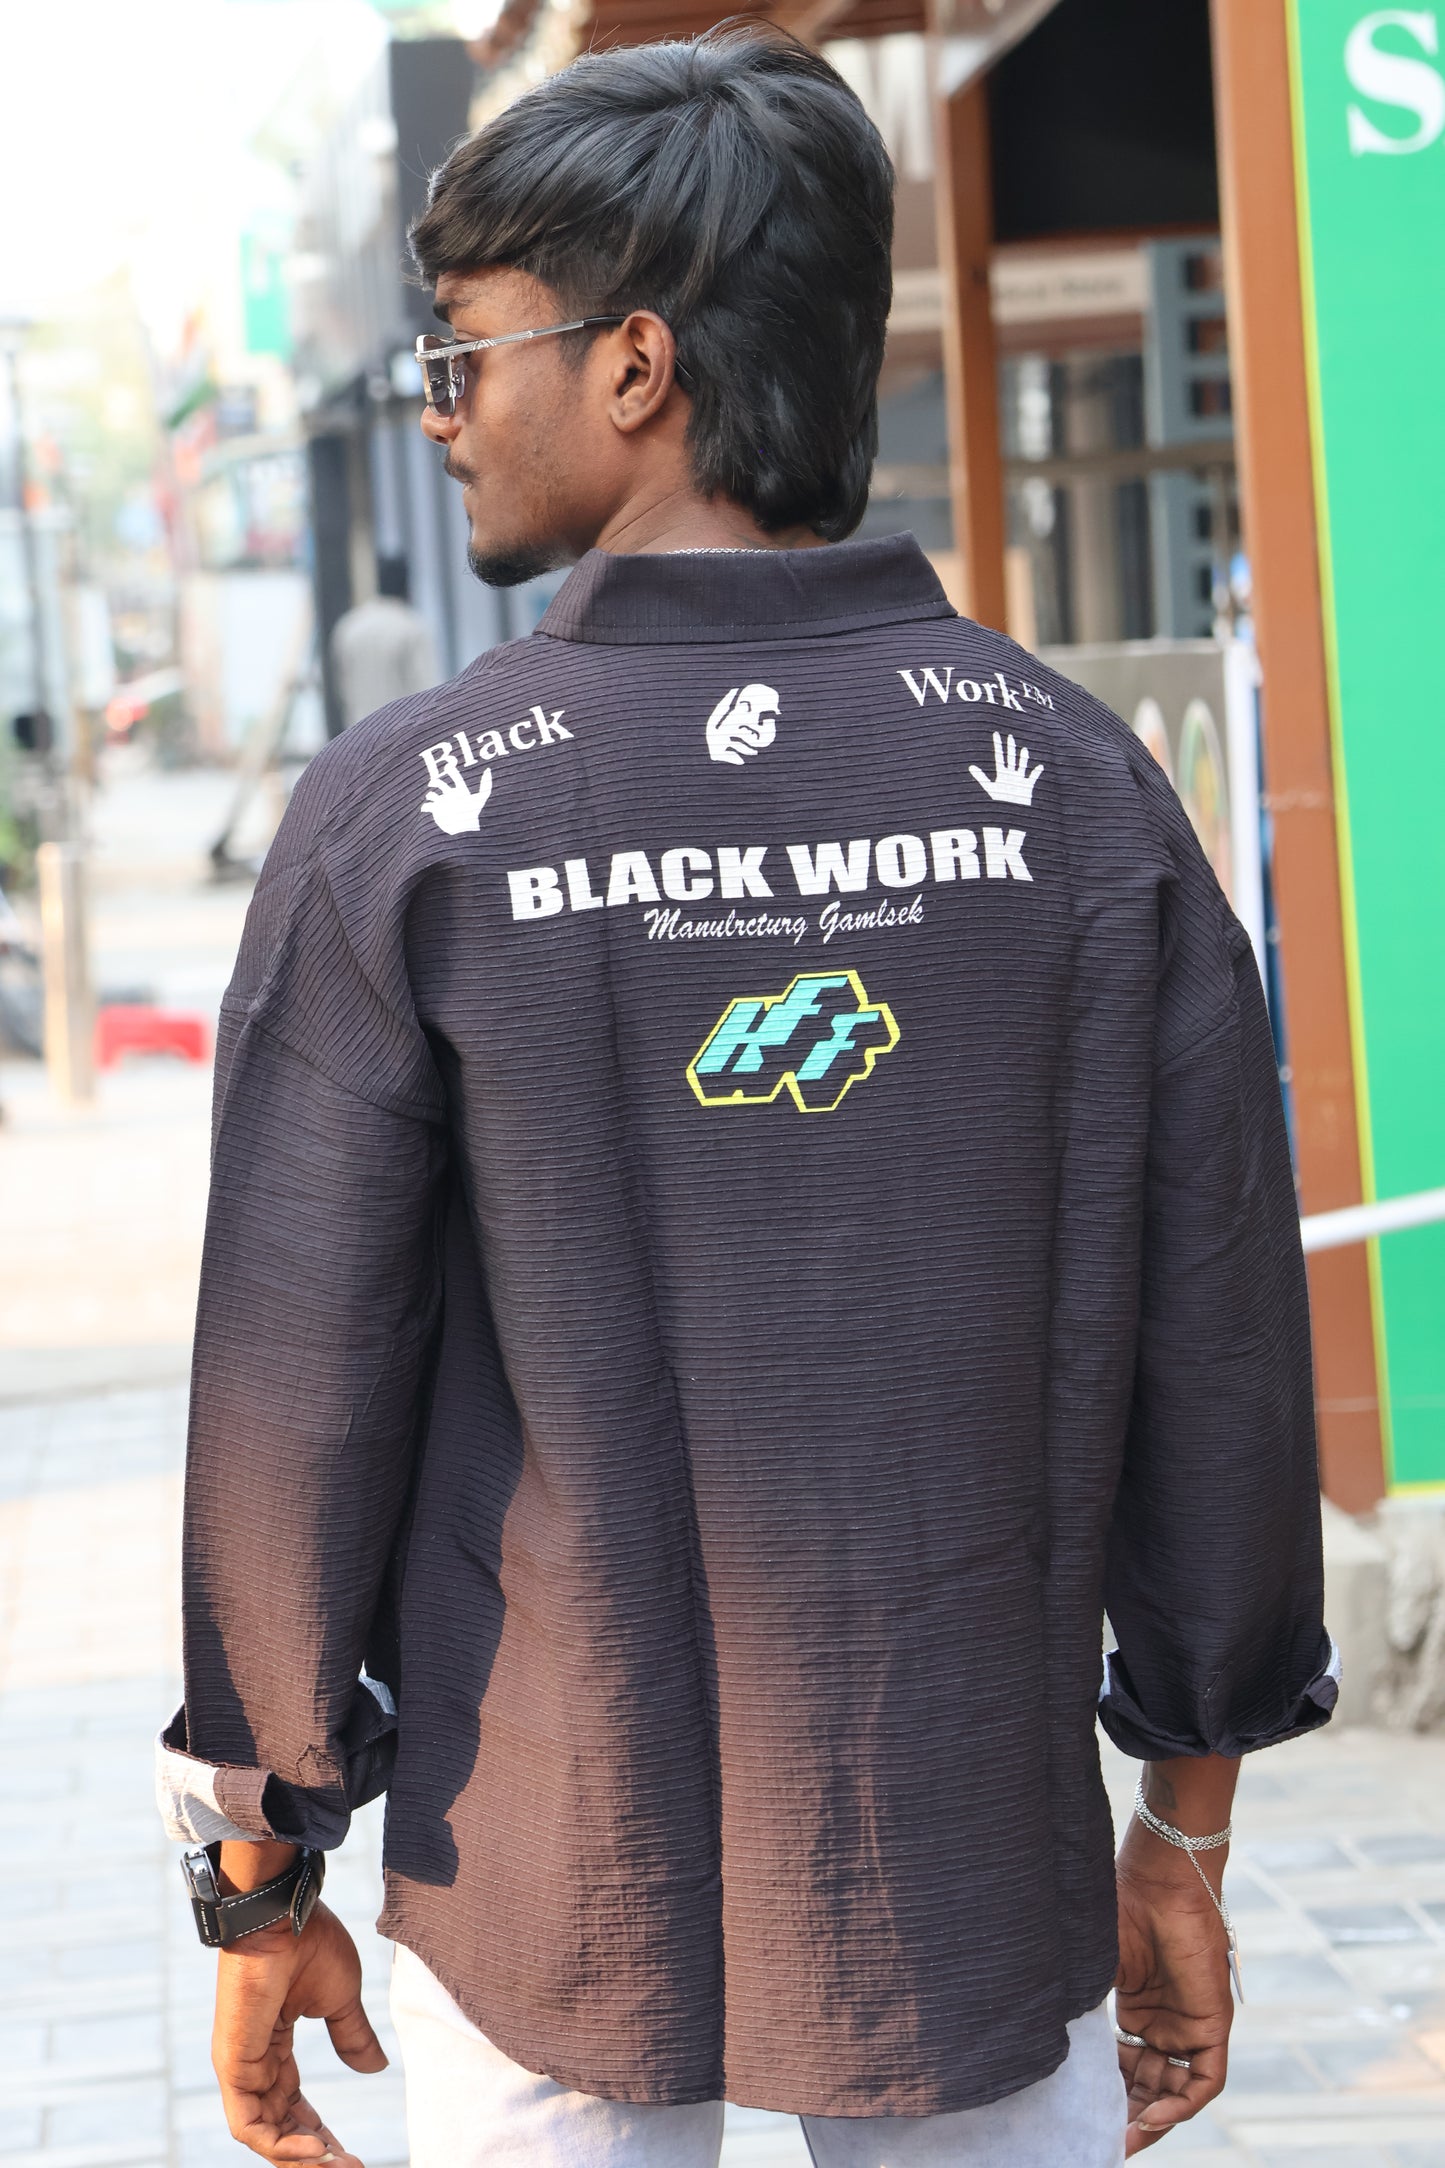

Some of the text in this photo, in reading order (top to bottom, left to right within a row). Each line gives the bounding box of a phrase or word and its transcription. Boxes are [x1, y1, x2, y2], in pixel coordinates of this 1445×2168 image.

[897, 667, 1027, 713] Work
[419, 705, 575, 788] Black
[507, 827, 1034, 921] BLACK WORK
